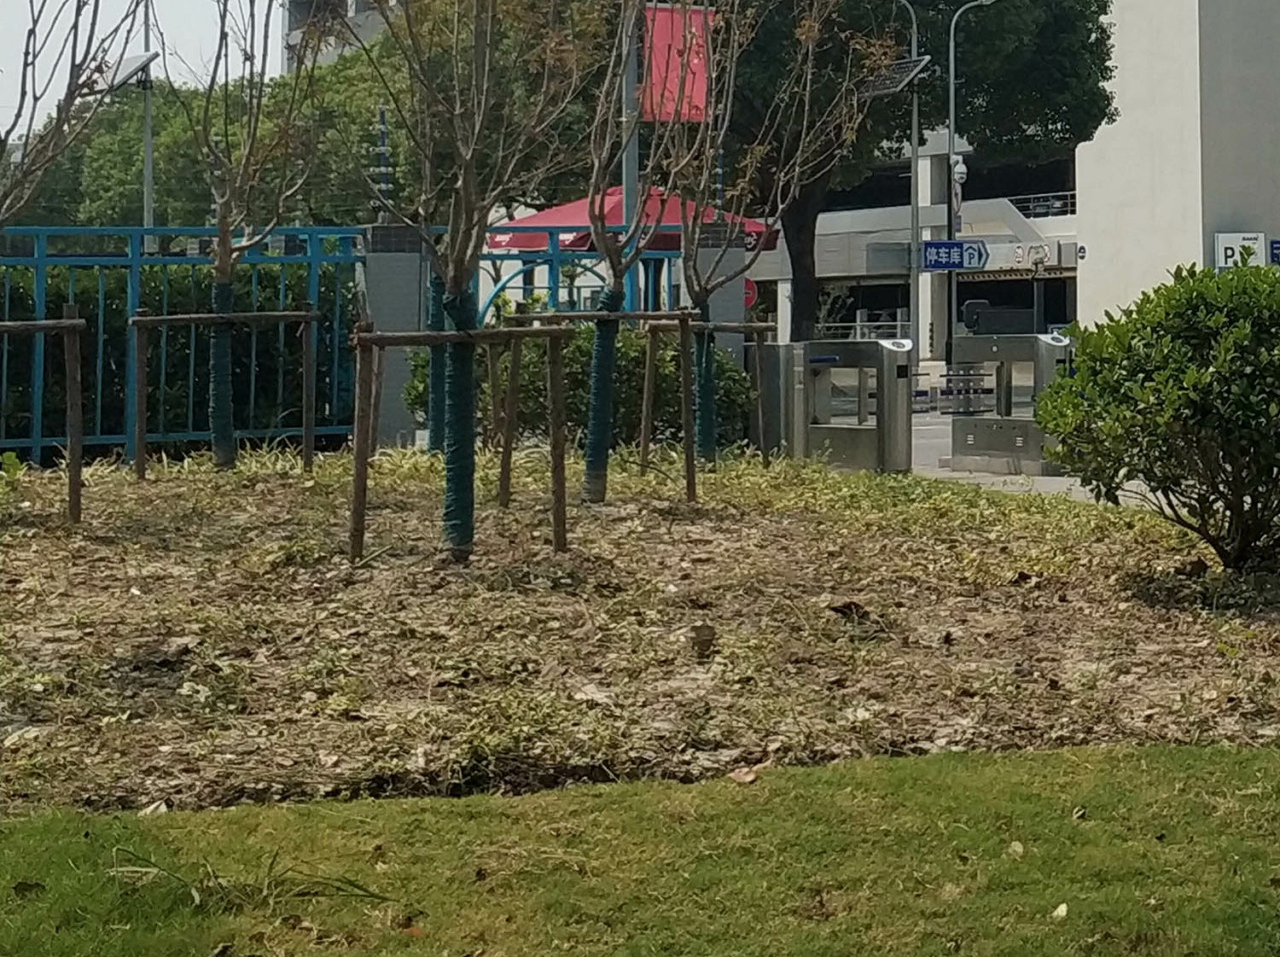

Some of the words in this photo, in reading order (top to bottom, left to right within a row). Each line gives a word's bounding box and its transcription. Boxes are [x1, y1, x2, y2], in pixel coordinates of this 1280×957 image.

[926, 247, 961, 264] 停车库
[1223, 246, 1235, 265] P
